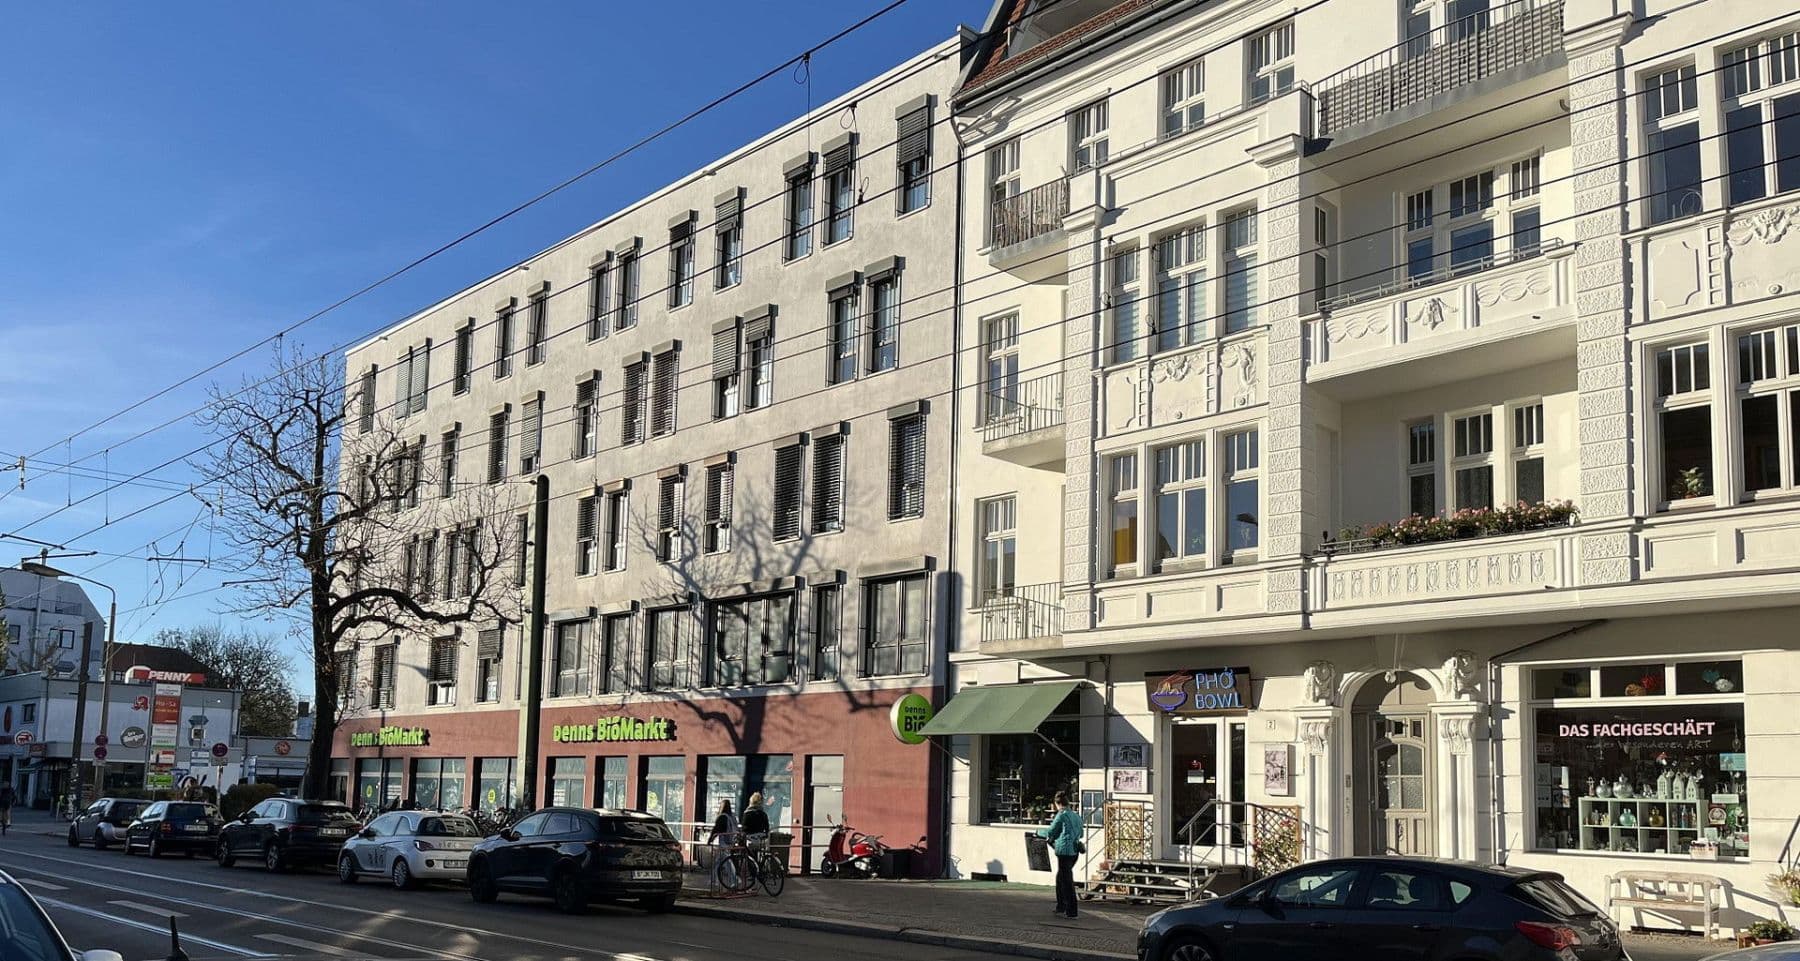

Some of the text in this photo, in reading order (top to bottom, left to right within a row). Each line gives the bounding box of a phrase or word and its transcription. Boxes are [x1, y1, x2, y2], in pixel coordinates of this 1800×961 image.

[1194, 691, 1245, 710] BOWL
[1559, 719, 1715, 737] DAS FACHGESCHÄFT
[1685, 739, 1713, 750] ART
